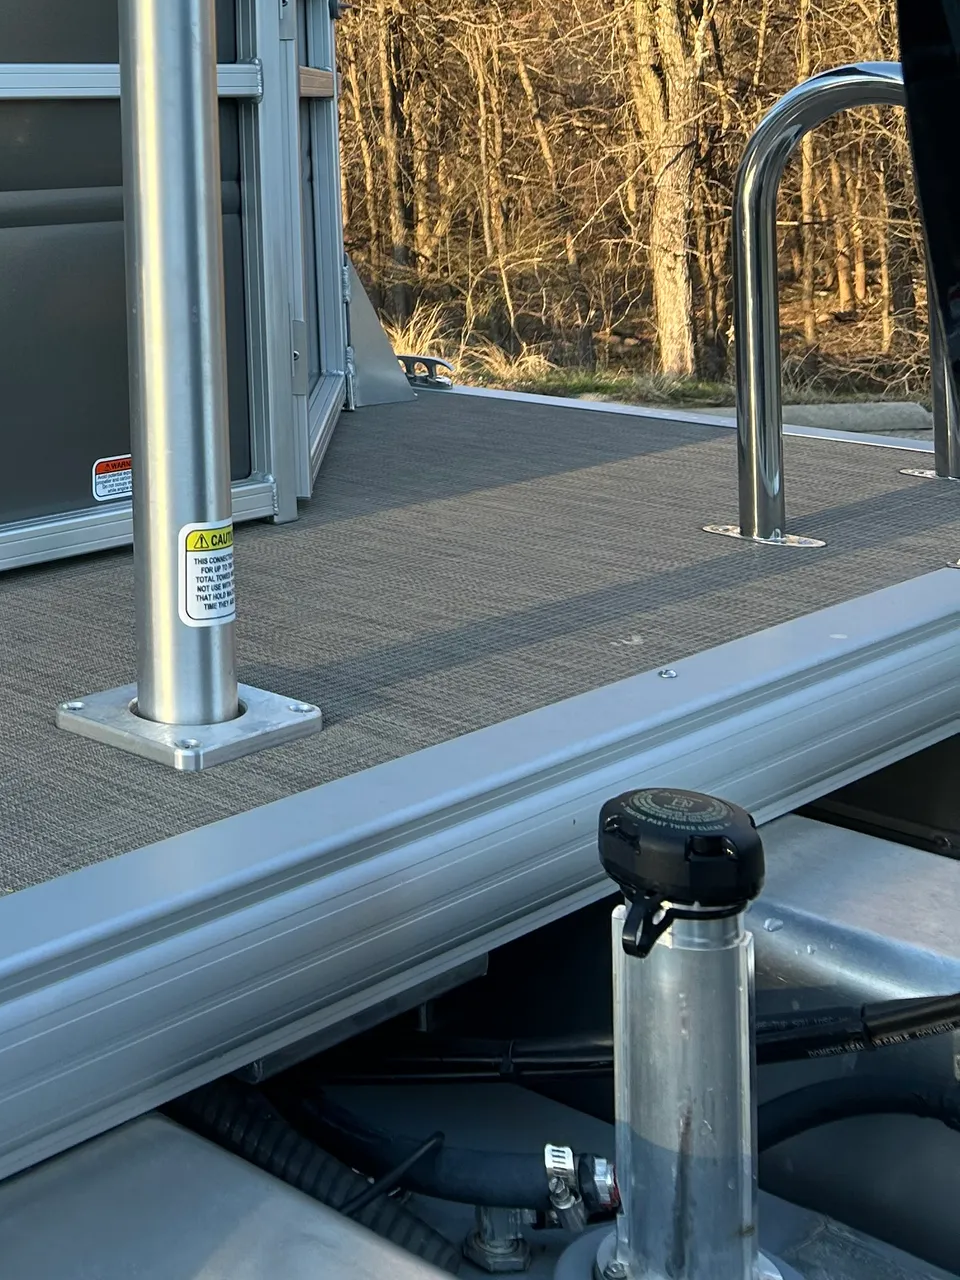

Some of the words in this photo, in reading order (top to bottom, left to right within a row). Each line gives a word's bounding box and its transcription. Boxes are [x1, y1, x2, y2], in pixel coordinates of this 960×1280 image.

[194, 557, 208, 565] THIS
[201, 566, 214, 574] FOR
[214, 565, 222, 573] UP
[211, 583, 221, 592] USE
[195, 594, 212, 602] THAT
[212, 591, 227, 601] HOLD
